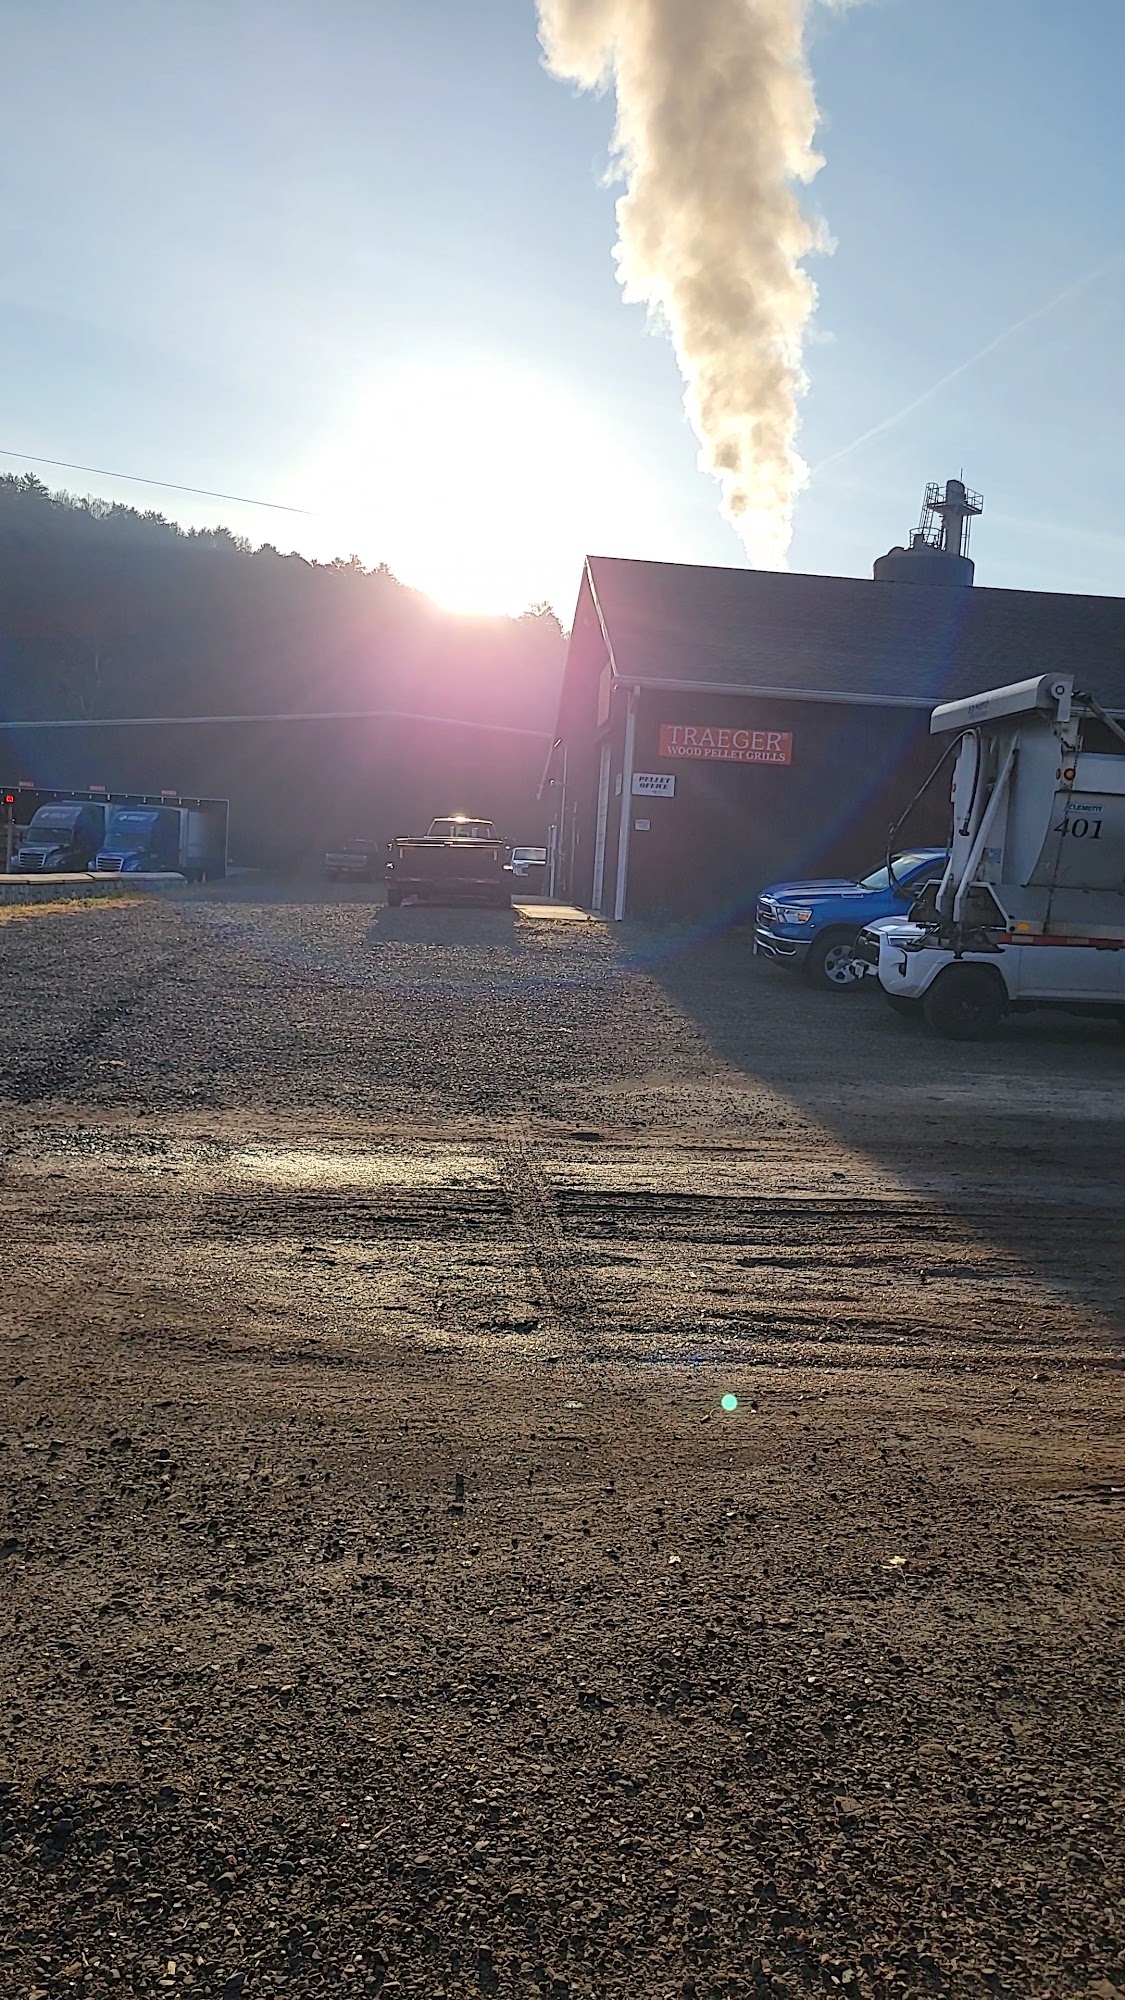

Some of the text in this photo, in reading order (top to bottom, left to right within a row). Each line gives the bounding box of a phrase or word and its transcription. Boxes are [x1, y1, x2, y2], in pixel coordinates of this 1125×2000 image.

[668, 726, 782, 751] TRAEGER
[668, 746, 786, 762] WOOD PELLET GRILLS
[639, 776, 671, 784] PELLET
[1054, 818, 1103, 840] 401
